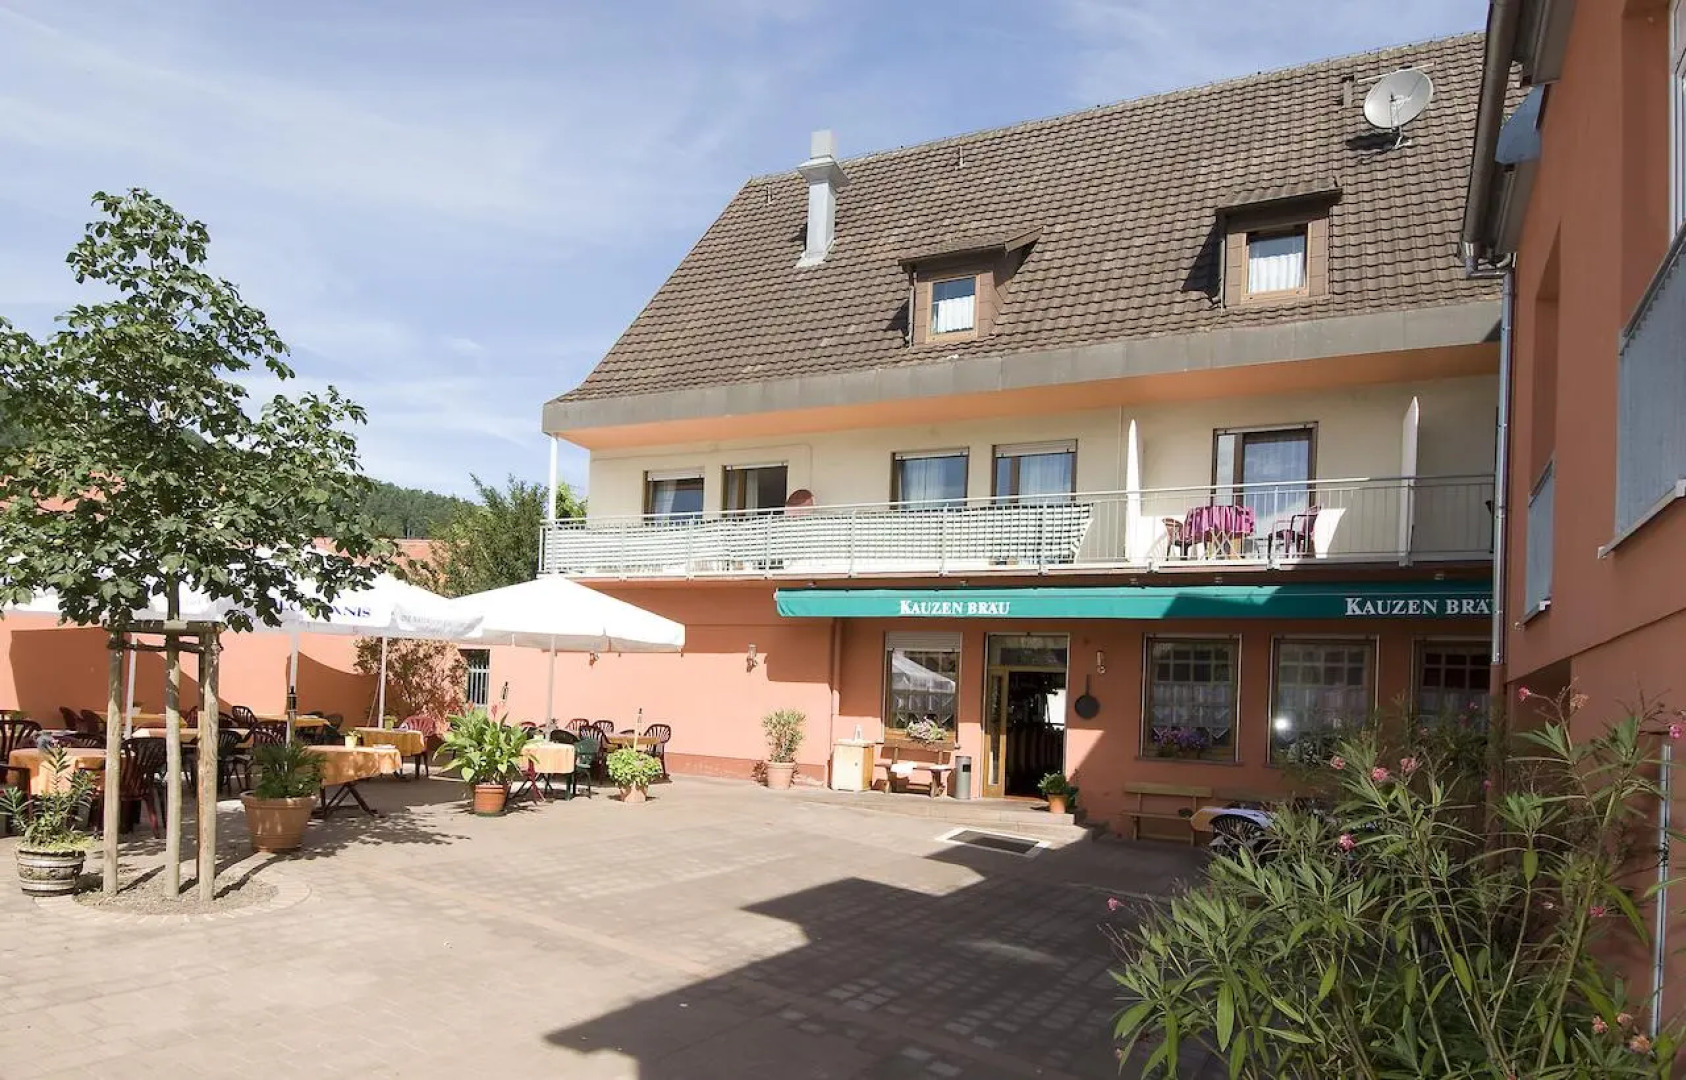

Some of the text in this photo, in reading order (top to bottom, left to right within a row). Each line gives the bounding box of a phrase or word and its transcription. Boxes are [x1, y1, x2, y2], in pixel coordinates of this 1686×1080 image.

[900, 600, 1011, 615] KAUZEN BRÄU
[1345, 597, 1493, 615] KAUZEN BRÄ
